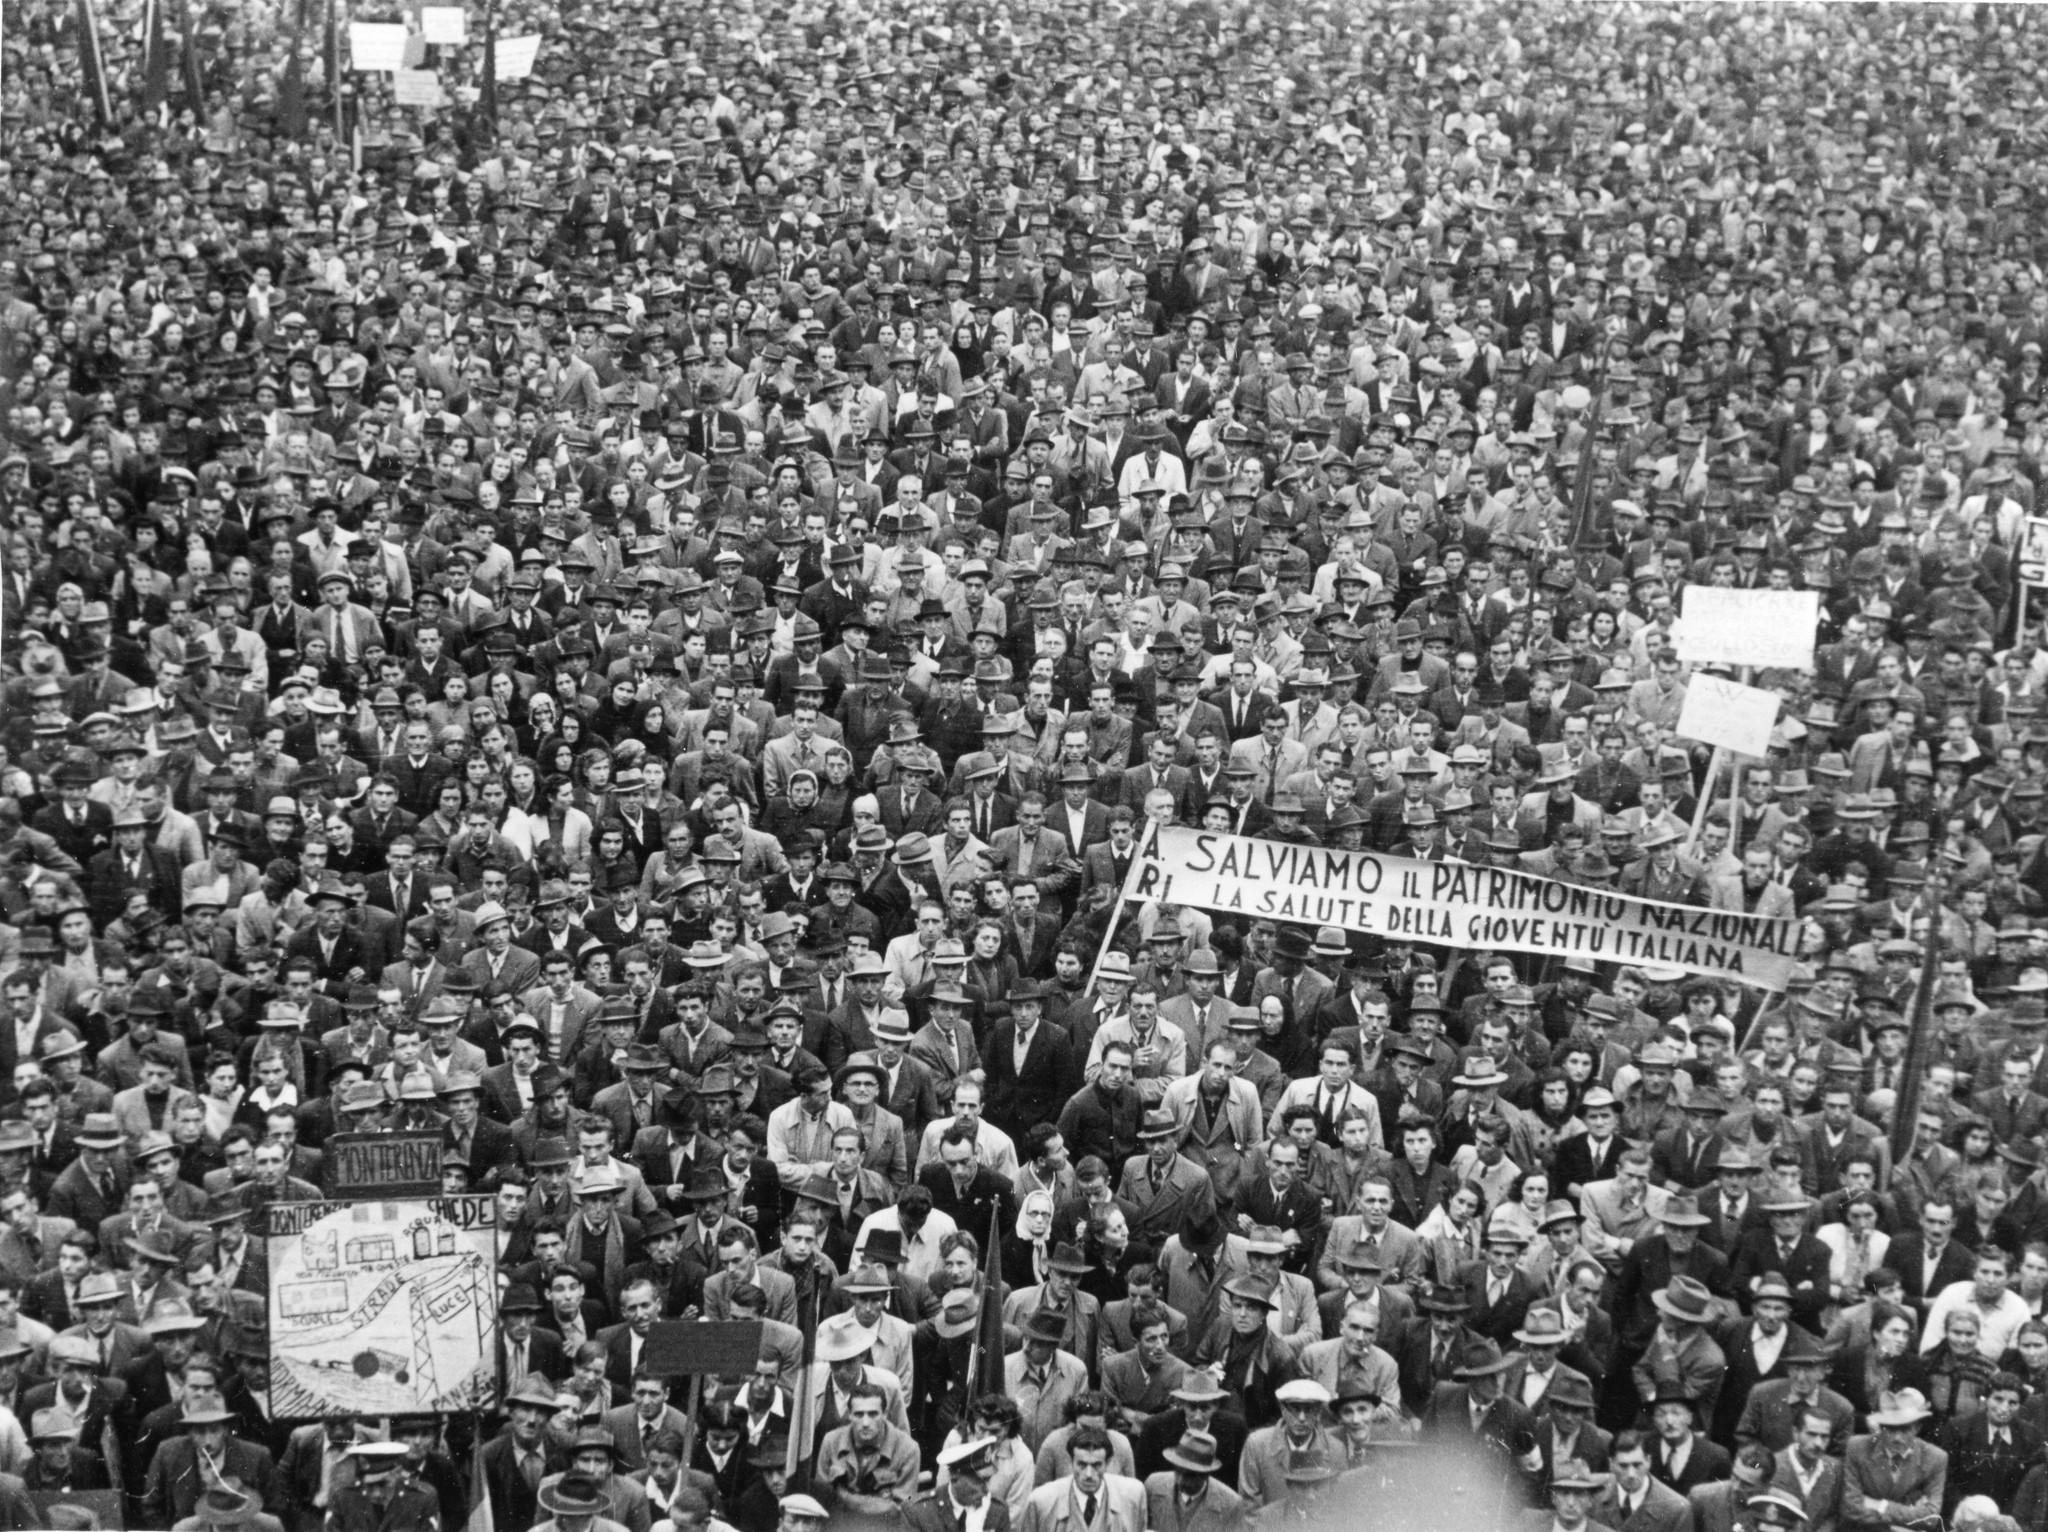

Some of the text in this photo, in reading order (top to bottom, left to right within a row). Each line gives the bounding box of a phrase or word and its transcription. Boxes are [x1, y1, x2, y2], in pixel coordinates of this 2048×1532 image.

[1186, 834, 1382, 894] SALVIAMO
[1402, 871, 1421, 899] IL
[1432, 862, 1625, 921] PATRIMONIO
[1213, 883, 1241, 909] LA
[1257, 890, 1373, 928] SALUTE
[1388, 905, 1453, 939] DELLA
[1615, 930, 1744, 973] ITALIANA
[427, 1198, 494, 1229] CHIEDE
[352, 1271, 407, 1329] STRADE
[433, 1290, 467, 1318] LUCE
